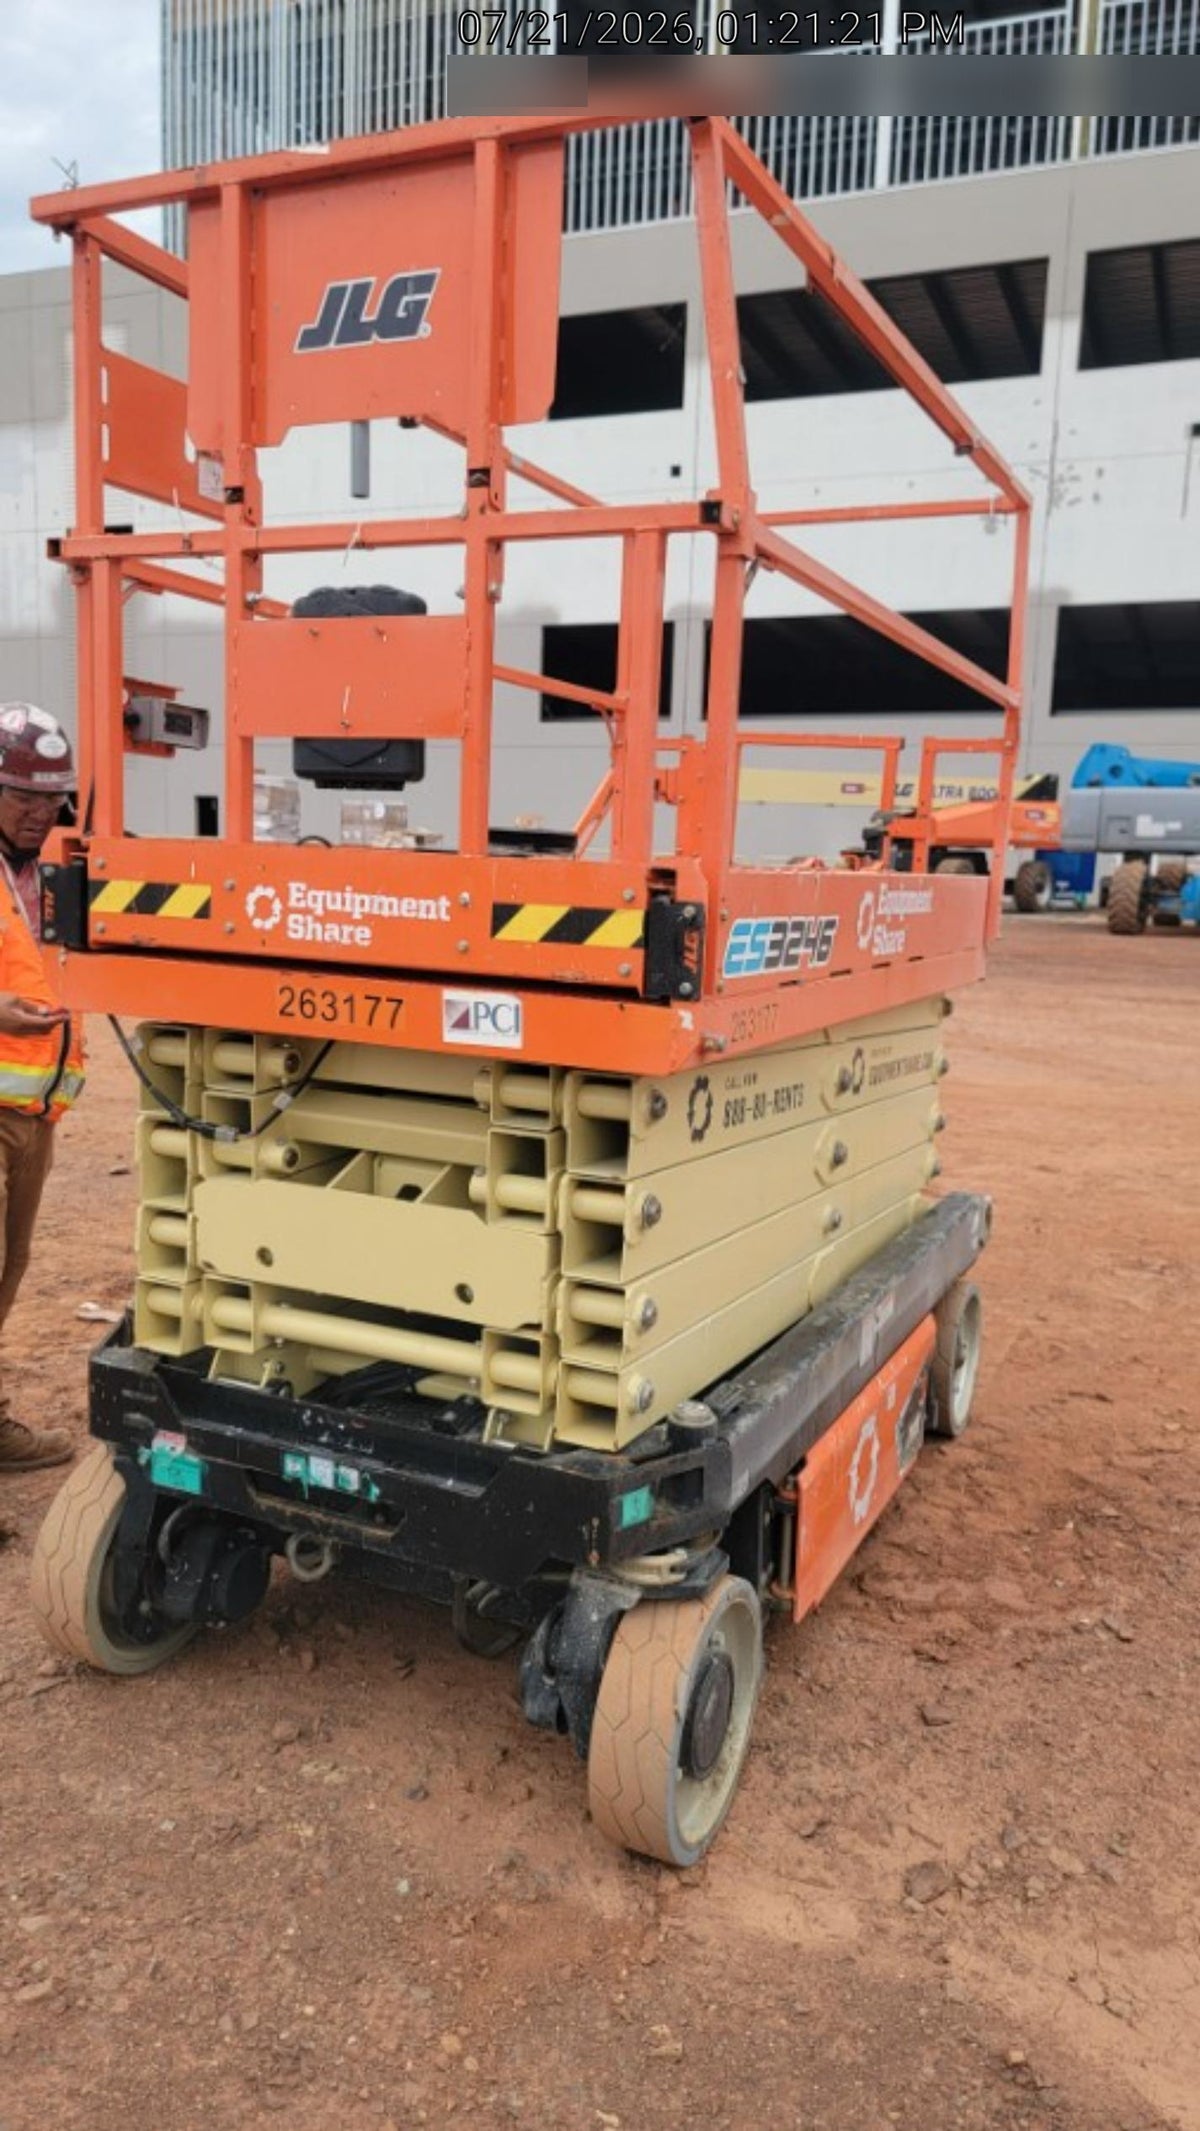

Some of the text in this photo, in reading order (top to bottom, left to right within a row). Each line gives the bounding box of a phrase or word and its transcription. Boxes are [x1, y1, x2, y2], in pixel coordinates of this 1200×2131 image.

[294, 268, 441, 353] JLG
[286, 881, 451, 922] Equipment
[286, 912, 373, 947] Share
[723, 915, 839, 979] ES3246
[683, 928, 699, 976] JLG
[277, 985, 404, 1029] 263177
[473, 1001, 521, 1034] PCI
